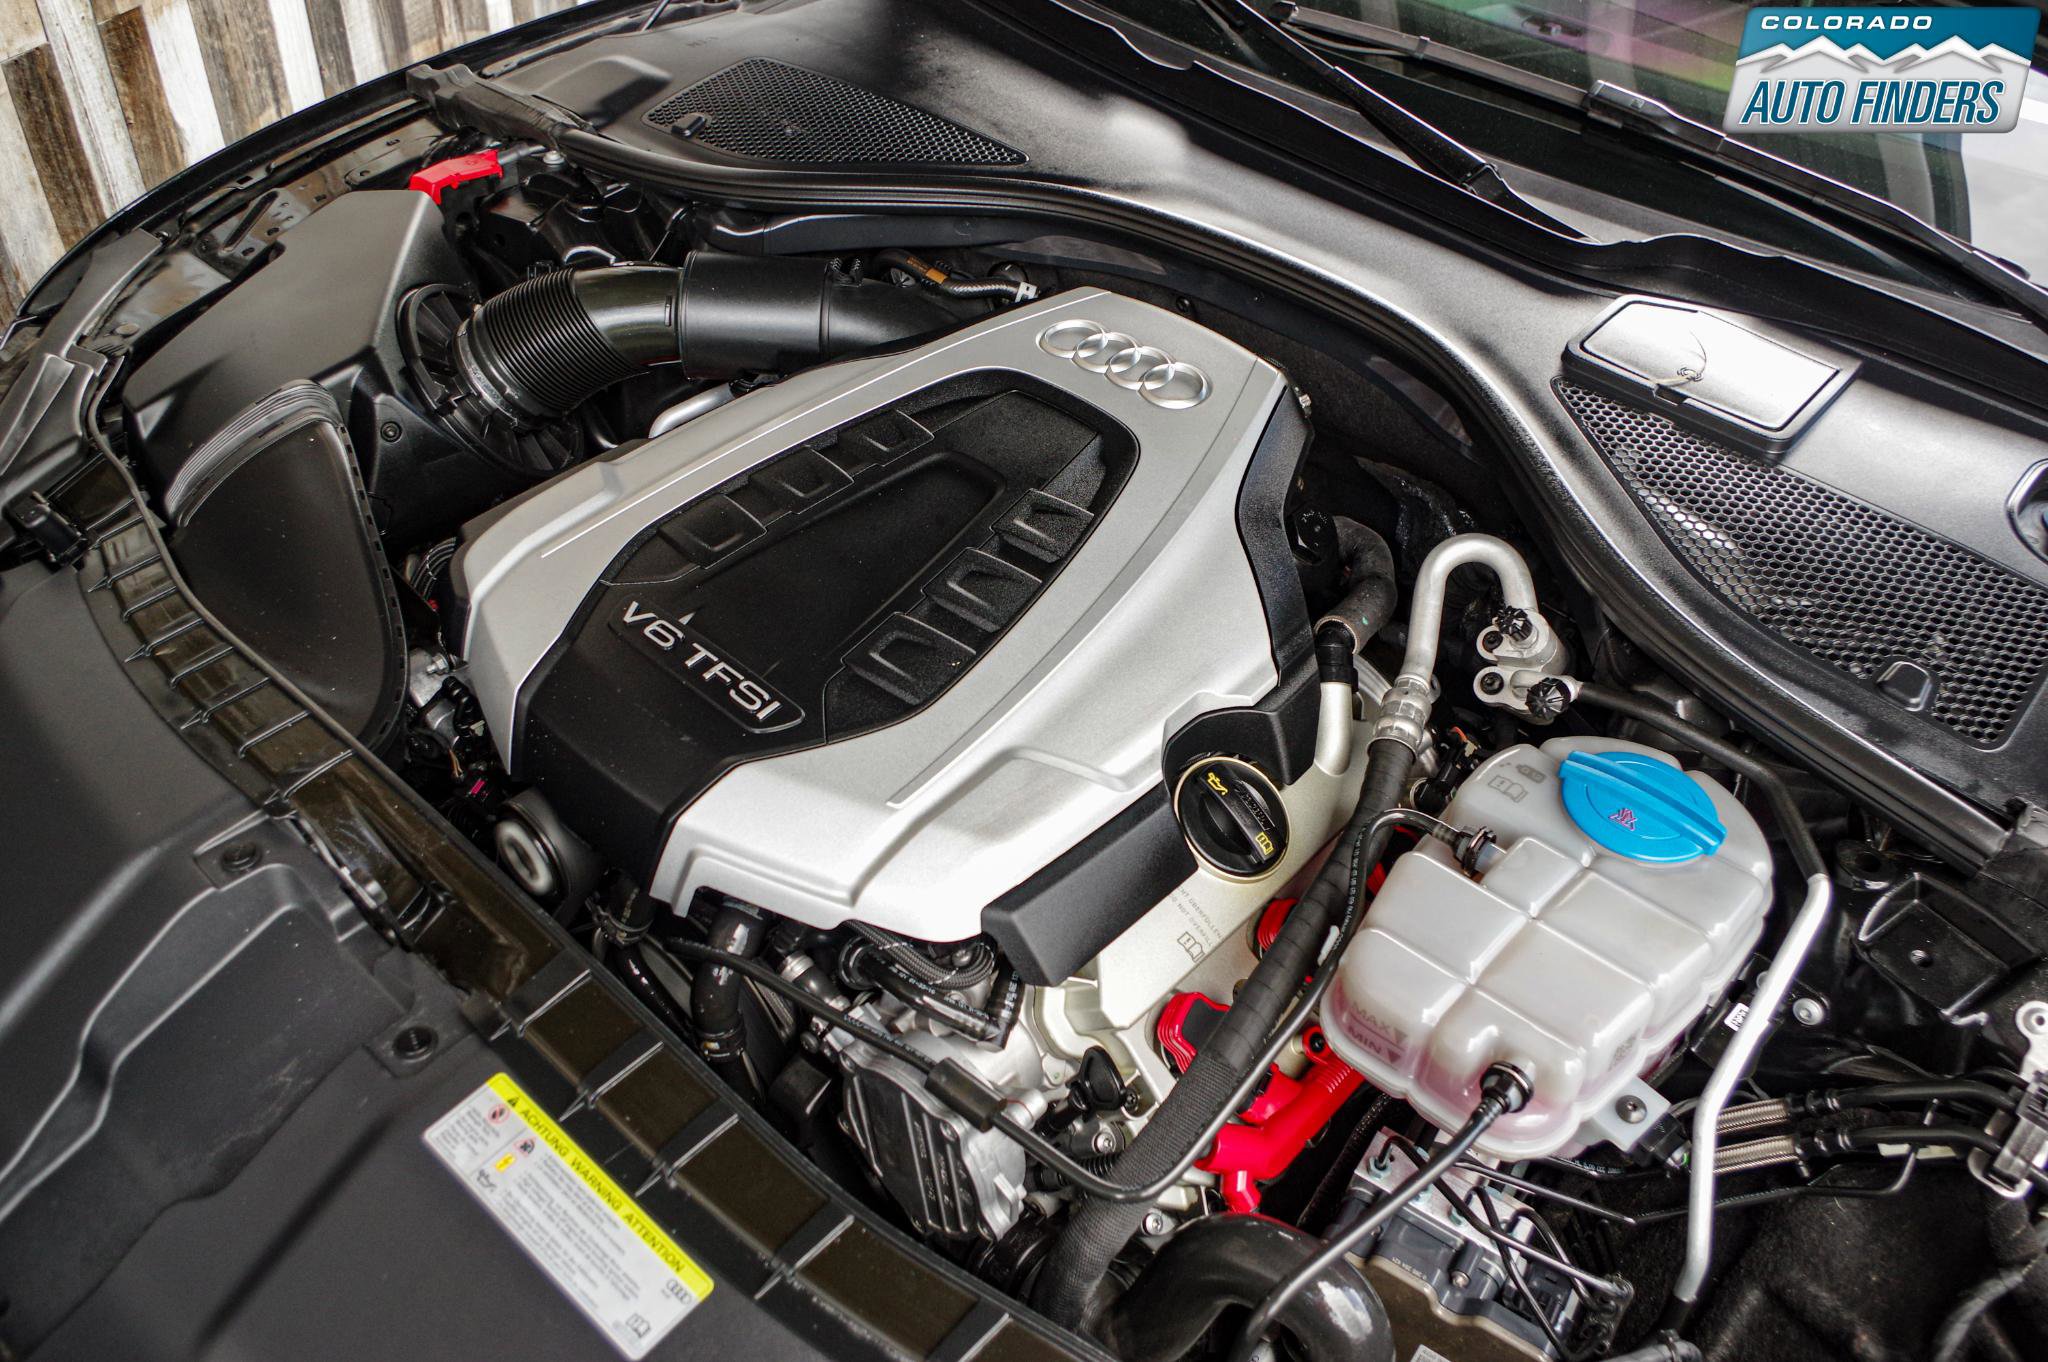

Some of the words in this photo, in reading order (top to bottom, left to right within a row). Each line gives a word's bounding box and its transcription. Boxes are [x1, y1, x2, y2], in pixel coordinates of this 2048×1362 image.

[623, 601, 685, 649] V6
[684, 642, 781, 720] TFSI
[1347, 1025, 1382, 1054] MIN
[520, 1109, 568, 1157] ACHTUNG
[571, 1158, 623, 1211] WARNING
[623, 1212, 686, 1274] ATTENTION
